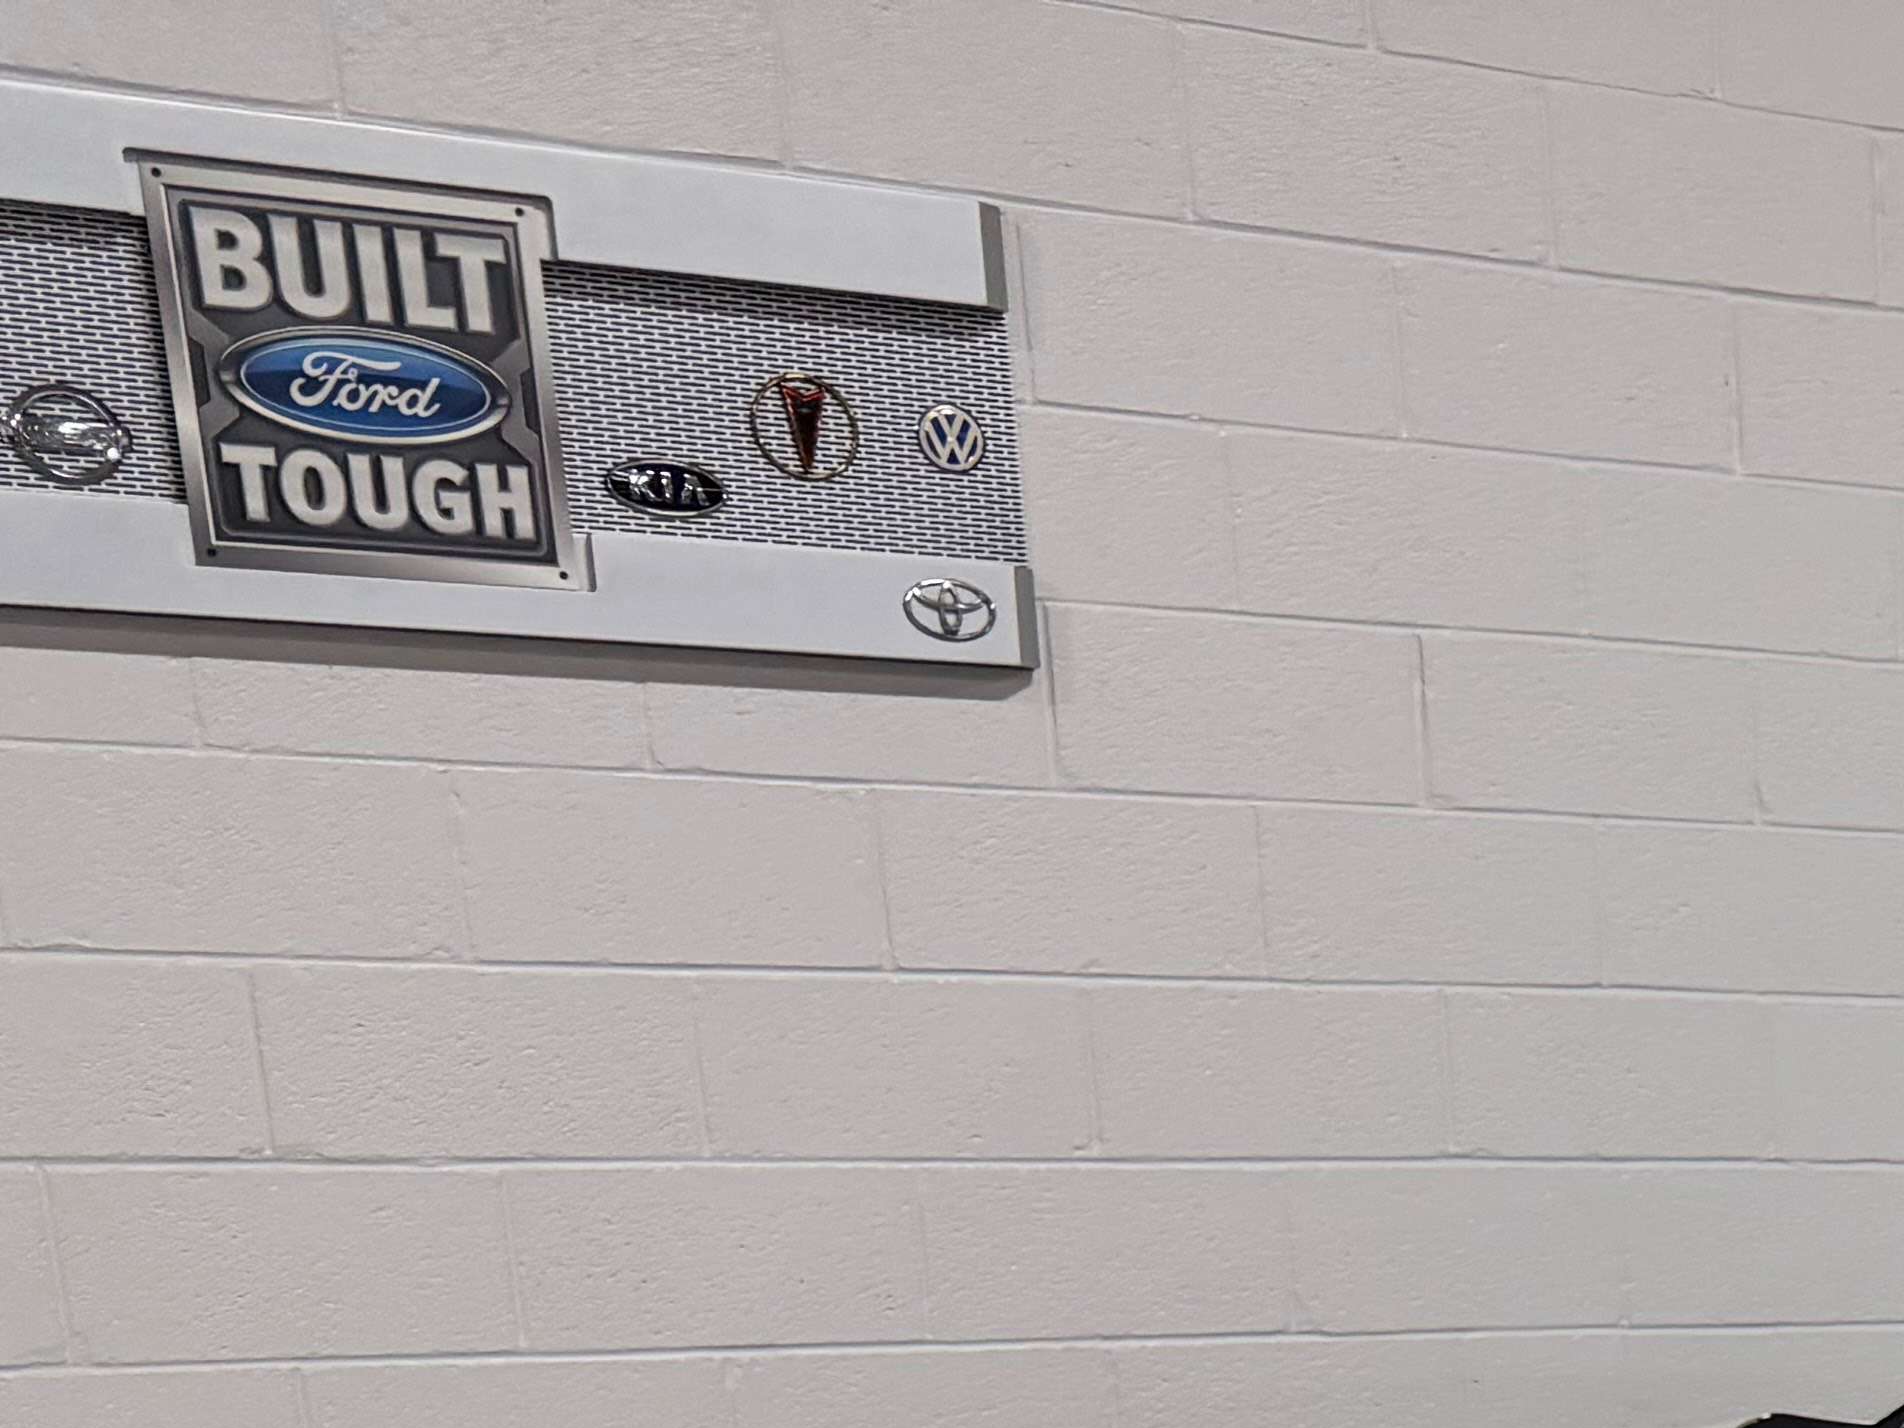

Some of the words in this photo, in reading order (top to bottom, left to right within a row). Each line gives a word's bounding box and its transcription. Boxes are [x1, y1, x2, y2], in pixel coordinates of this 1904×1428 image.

[188, 205, 507, 335] BUILT
[289, 350, 442, 418] Ford
[220, 441, 537, 542] TOUGH
[628, 468, 710, 507] KIA
